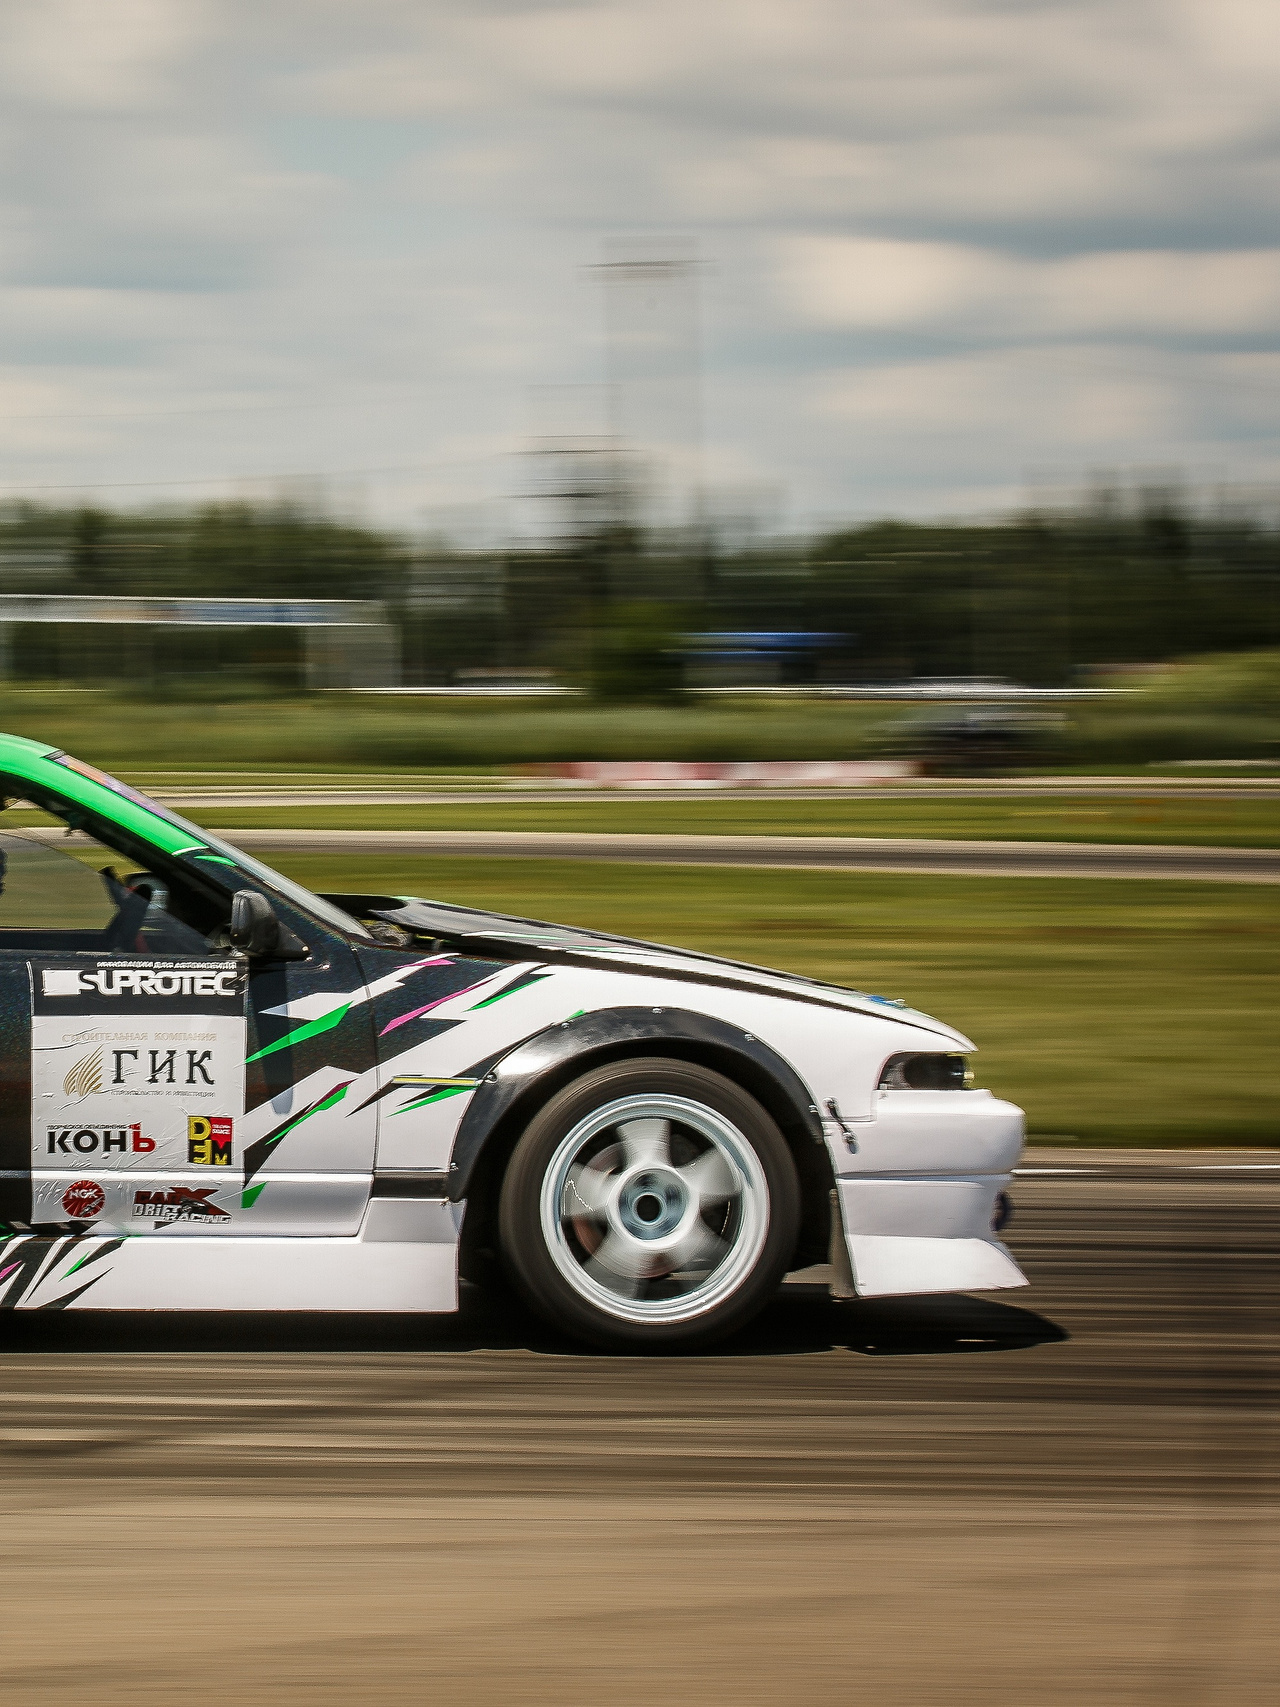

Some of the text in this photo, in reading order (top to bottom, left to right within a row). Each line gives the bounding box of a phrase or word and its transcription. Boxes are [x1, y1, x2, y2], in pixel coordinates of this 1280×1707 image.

[82, 969, 238, 996] SUPROTEC
[111, 1049, 216, 1086] ГИК
[69, 1188, 99, 1199] NGK
